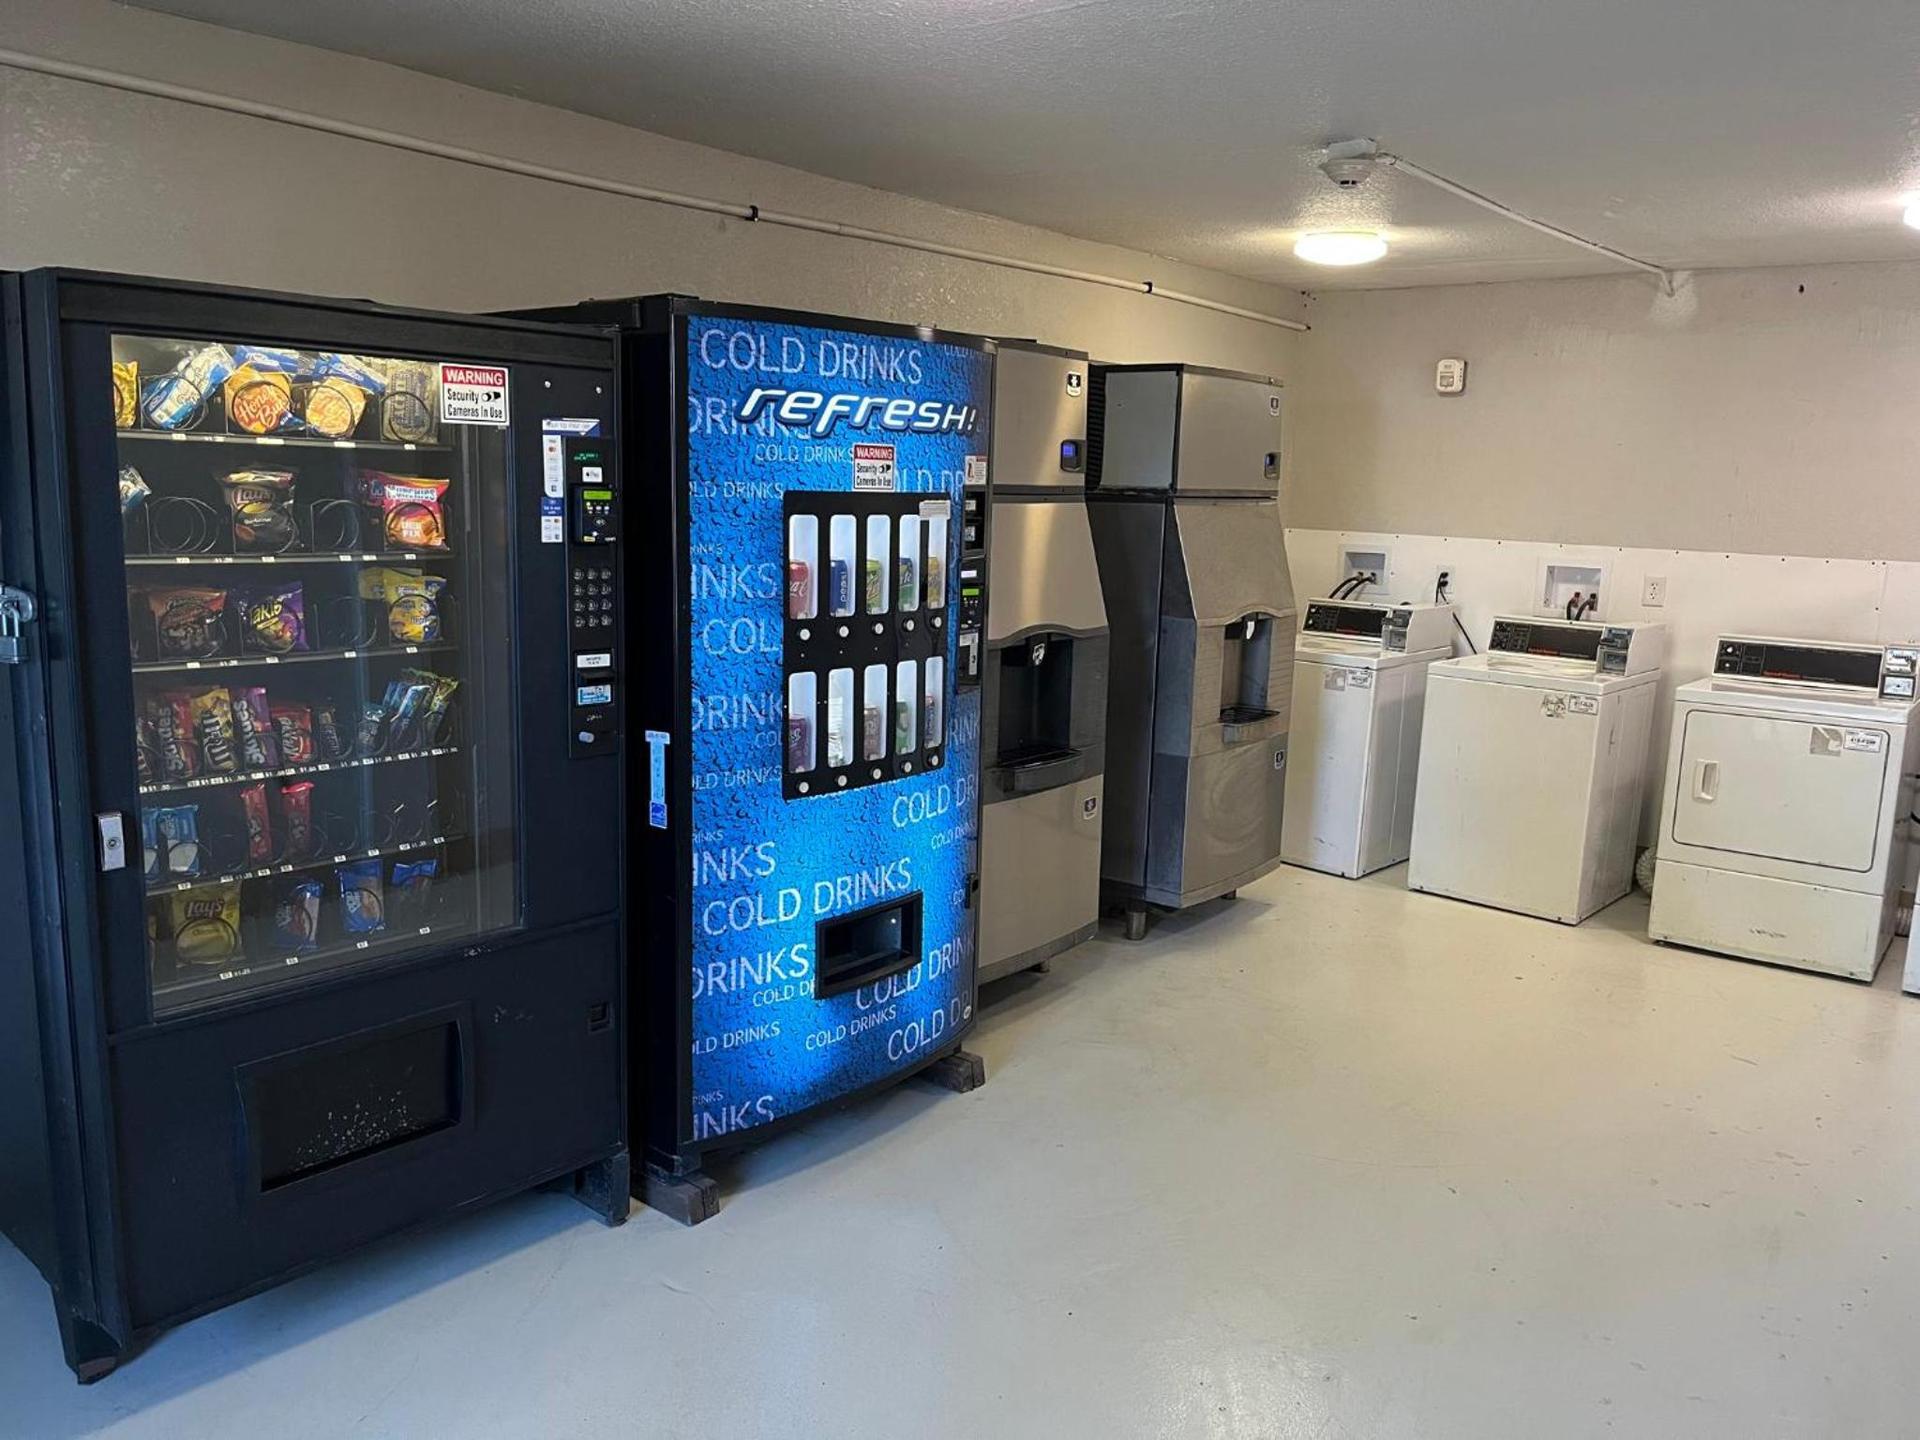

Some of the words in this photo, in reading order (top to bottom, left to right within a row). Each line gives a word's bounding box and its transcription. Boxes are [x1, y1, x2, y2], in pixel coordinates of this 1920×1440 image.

[701, 329, 806, 374] COLD
[819, 340, 922, 384] DRINKS
[445, 369, 503, 385] WARNING
[447, 388, 479, 404] Security
[447, 404, 479, 418] Cameras
[490, 406, 503, 419] Use
[755, 443, 798, 463] COLD
[804, 446, 854, 464] DRINKS
[856, 446, 893, 459] WARNING
[856, 463, 877, 475] Security
[856, 475, 876, 487] Cameras
[689, 481, 717, 498] LD
[723, 480, 784, 500] DRINKS
[691, 563, 777, 599] INKS
[250, 600, 283, 624] akis
[703, 617, 780, 655] COL
[693, 772, 717, 790] LD
[724, 764, 783, 788] DRINKS
[893, 784, 951, 828] COLD
[931, 829, 953, 850] COLD
[693, 841, 776, 887] INKS
[703, 887, 801, 936] COLD
[814, 857, 912, 916] DRINKS
[752, 983, 795, 1008] COLD
[855, 962, 922, 1010] COLD
[724, 1021, 781, 1050] DRINKS
[805, 1025, 847, 1052] COLD
[851, 1004, 897, 1036] DRINKS
[888, 1010, 944, 1062] COLD
[693, 1094, 775, 1141] INKS
